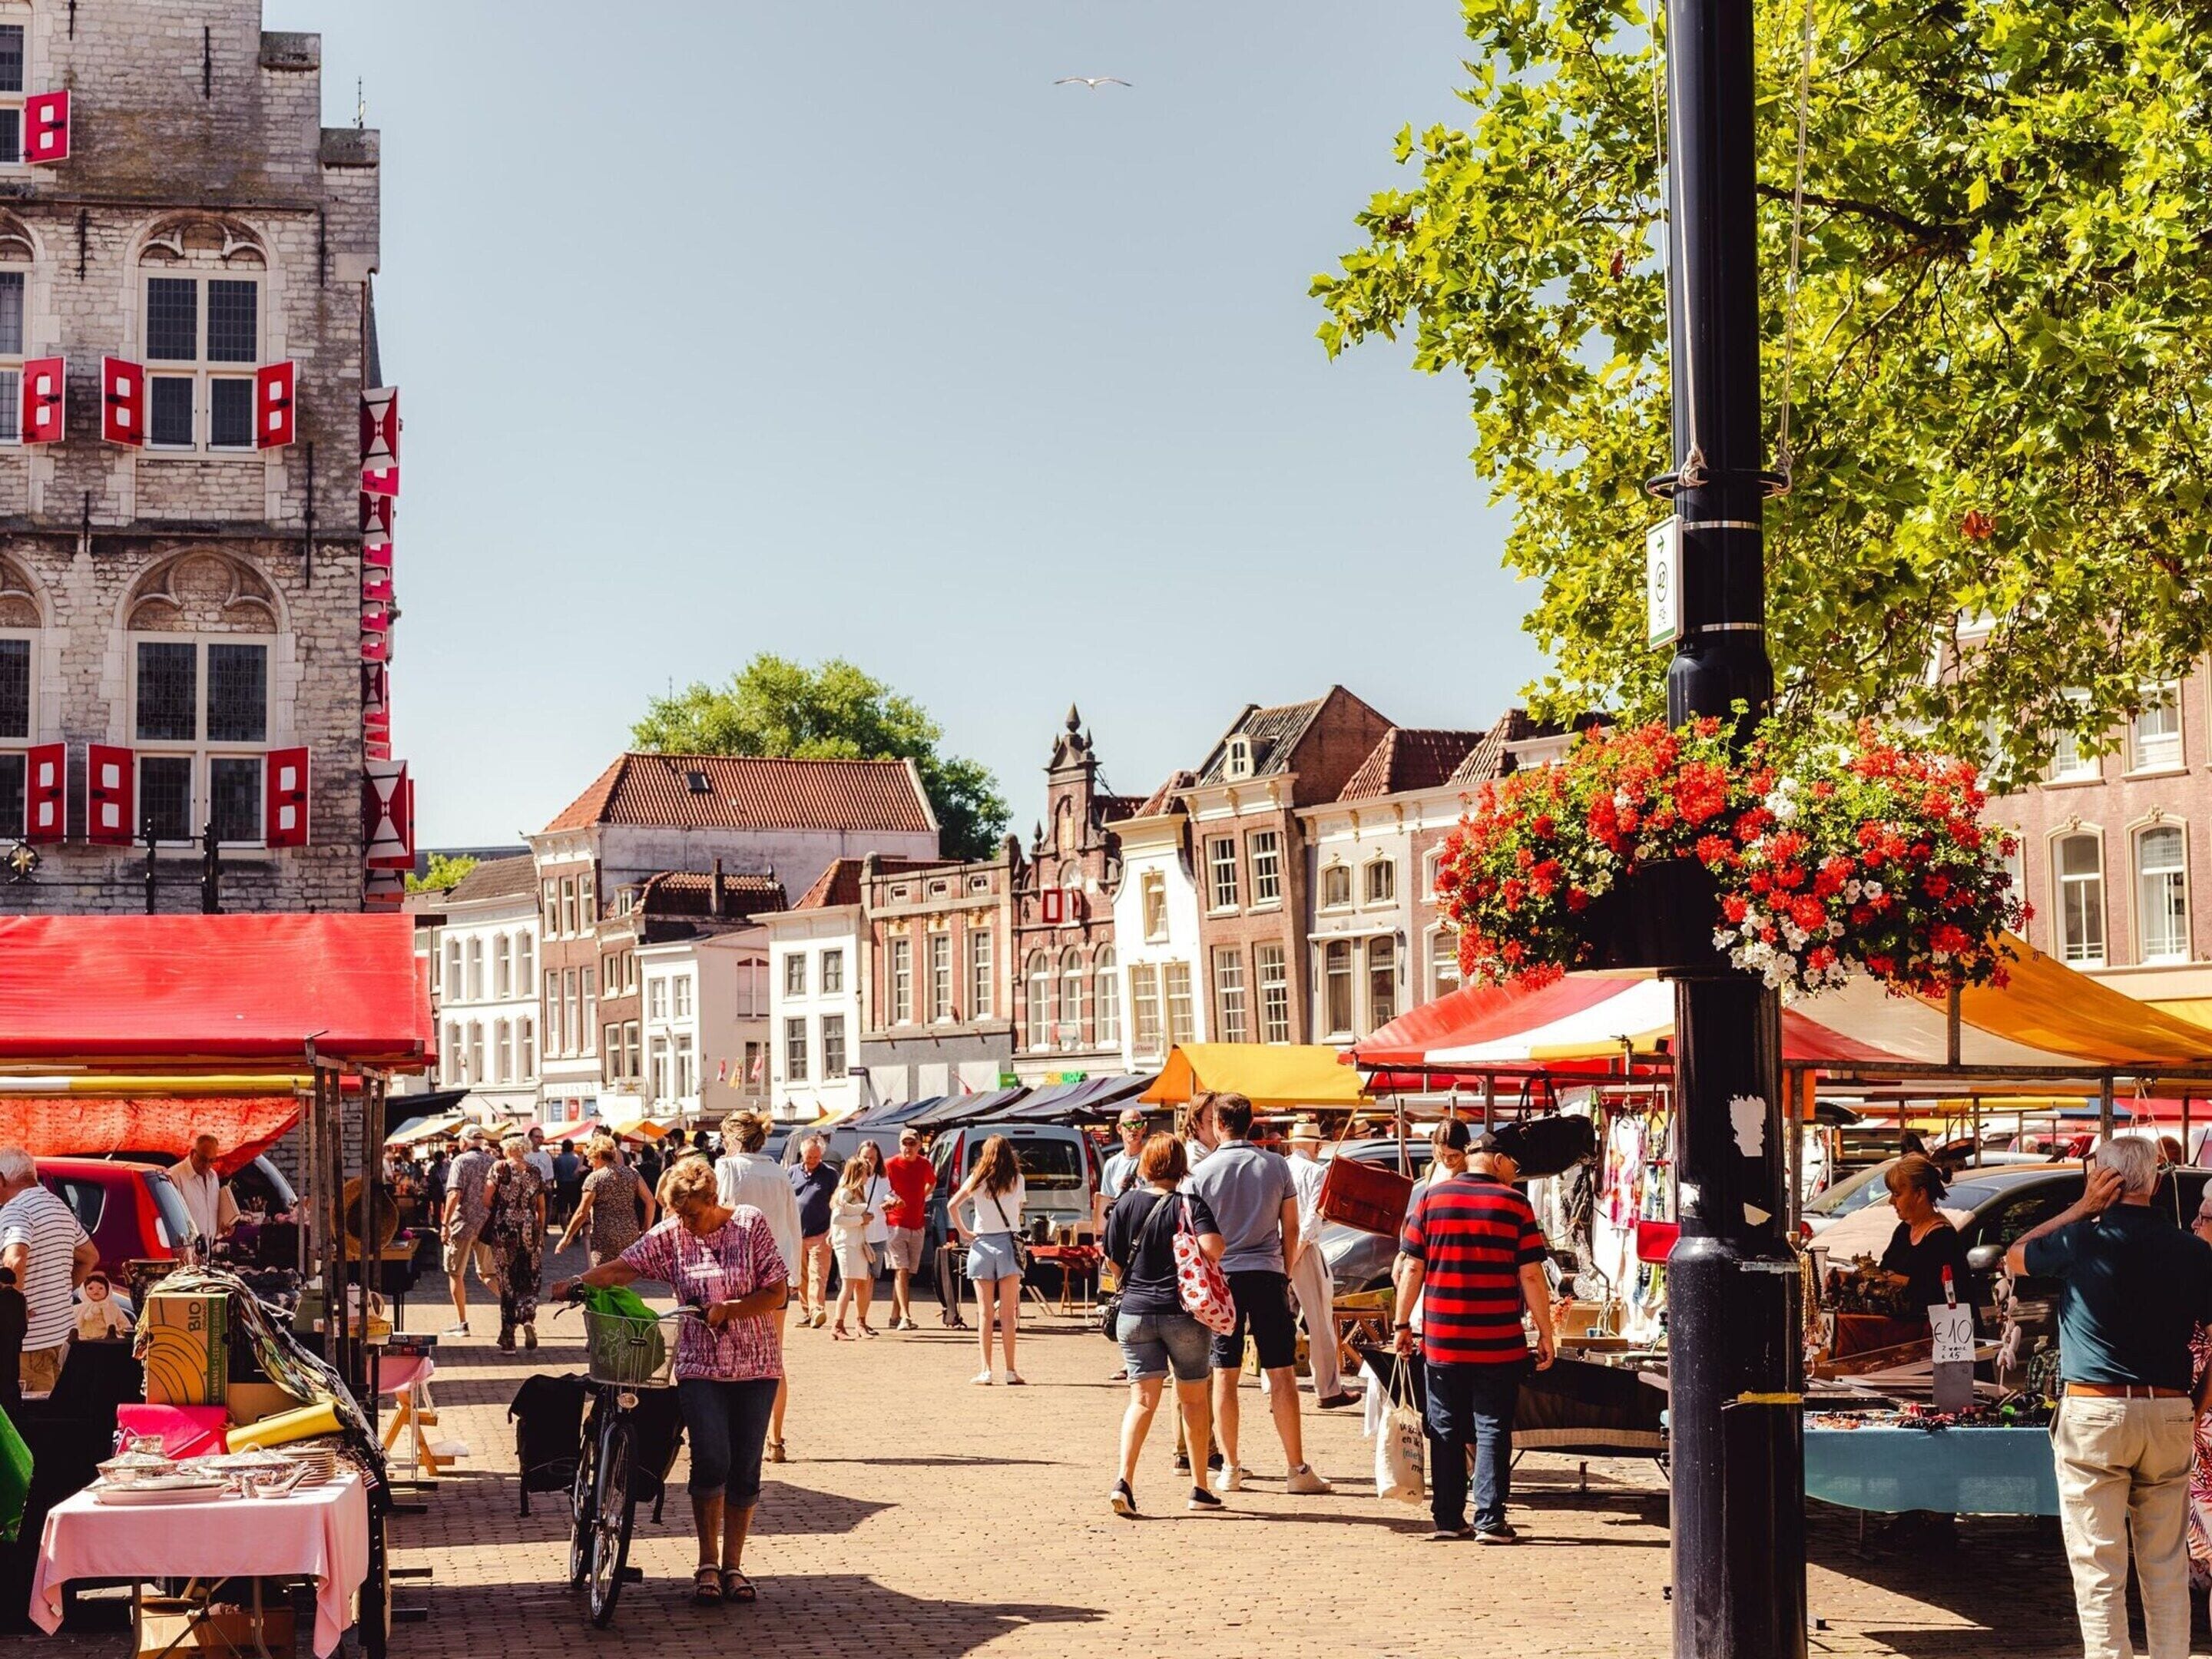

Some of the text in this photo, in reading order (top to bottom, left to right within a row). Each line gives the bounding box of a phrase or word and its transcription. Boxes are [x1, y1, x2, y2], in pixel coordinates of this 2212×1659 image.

[187, 1301, 201, 1332] BIO
[1934, 1318, 1973, 1343] €10
[212, 1328, 220, 1360] CERTIFIED
[212, 1365, 220, 1396] BANANAS
